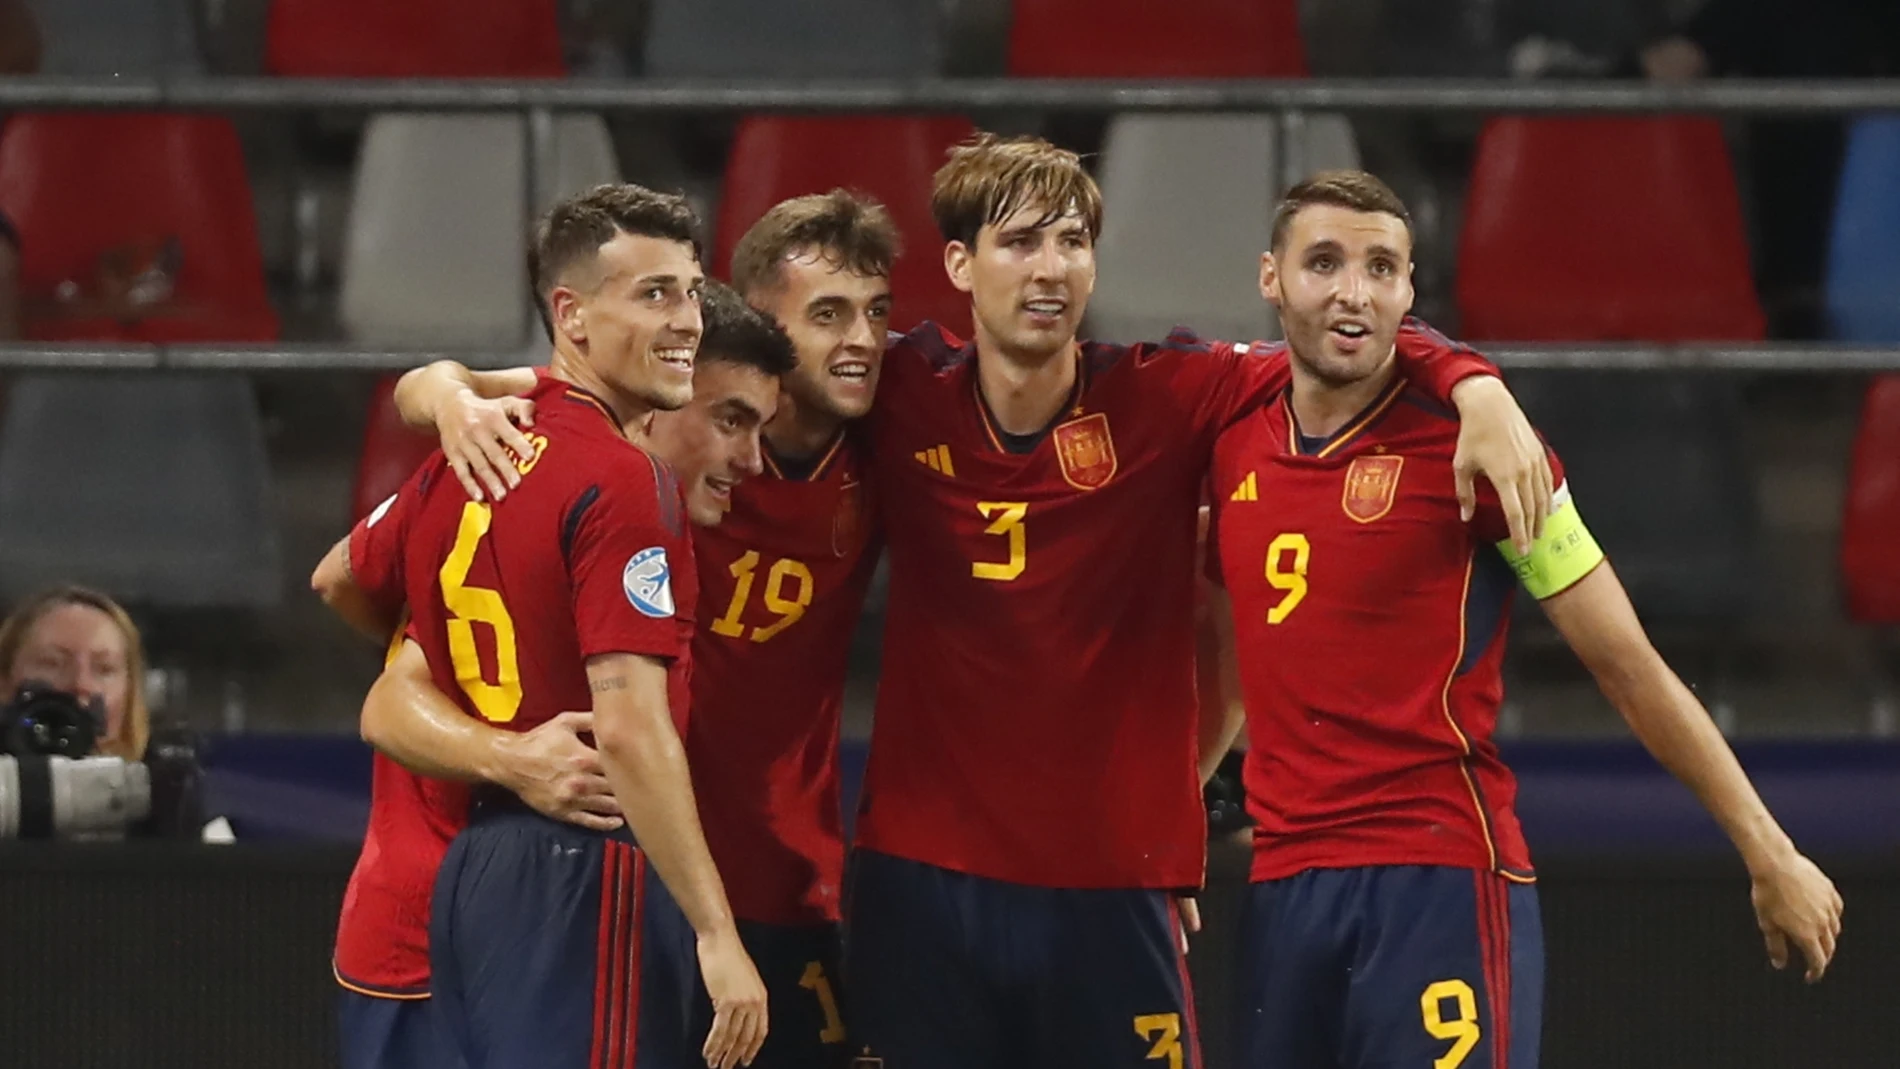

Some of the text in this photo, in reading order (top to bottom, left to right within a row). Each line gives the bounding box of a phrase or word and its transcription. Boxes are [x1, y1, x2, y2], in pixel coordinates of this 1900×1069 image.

[972, 502, 1029, 581] 3
[1265, 533, 1310, 624] 9
[440, 501, 523, 722] 6
[710, 549, 814, 643] 19
[1133, 1012, 1184, 1069] 3
[1420, 979, 1480, 1069] 9
